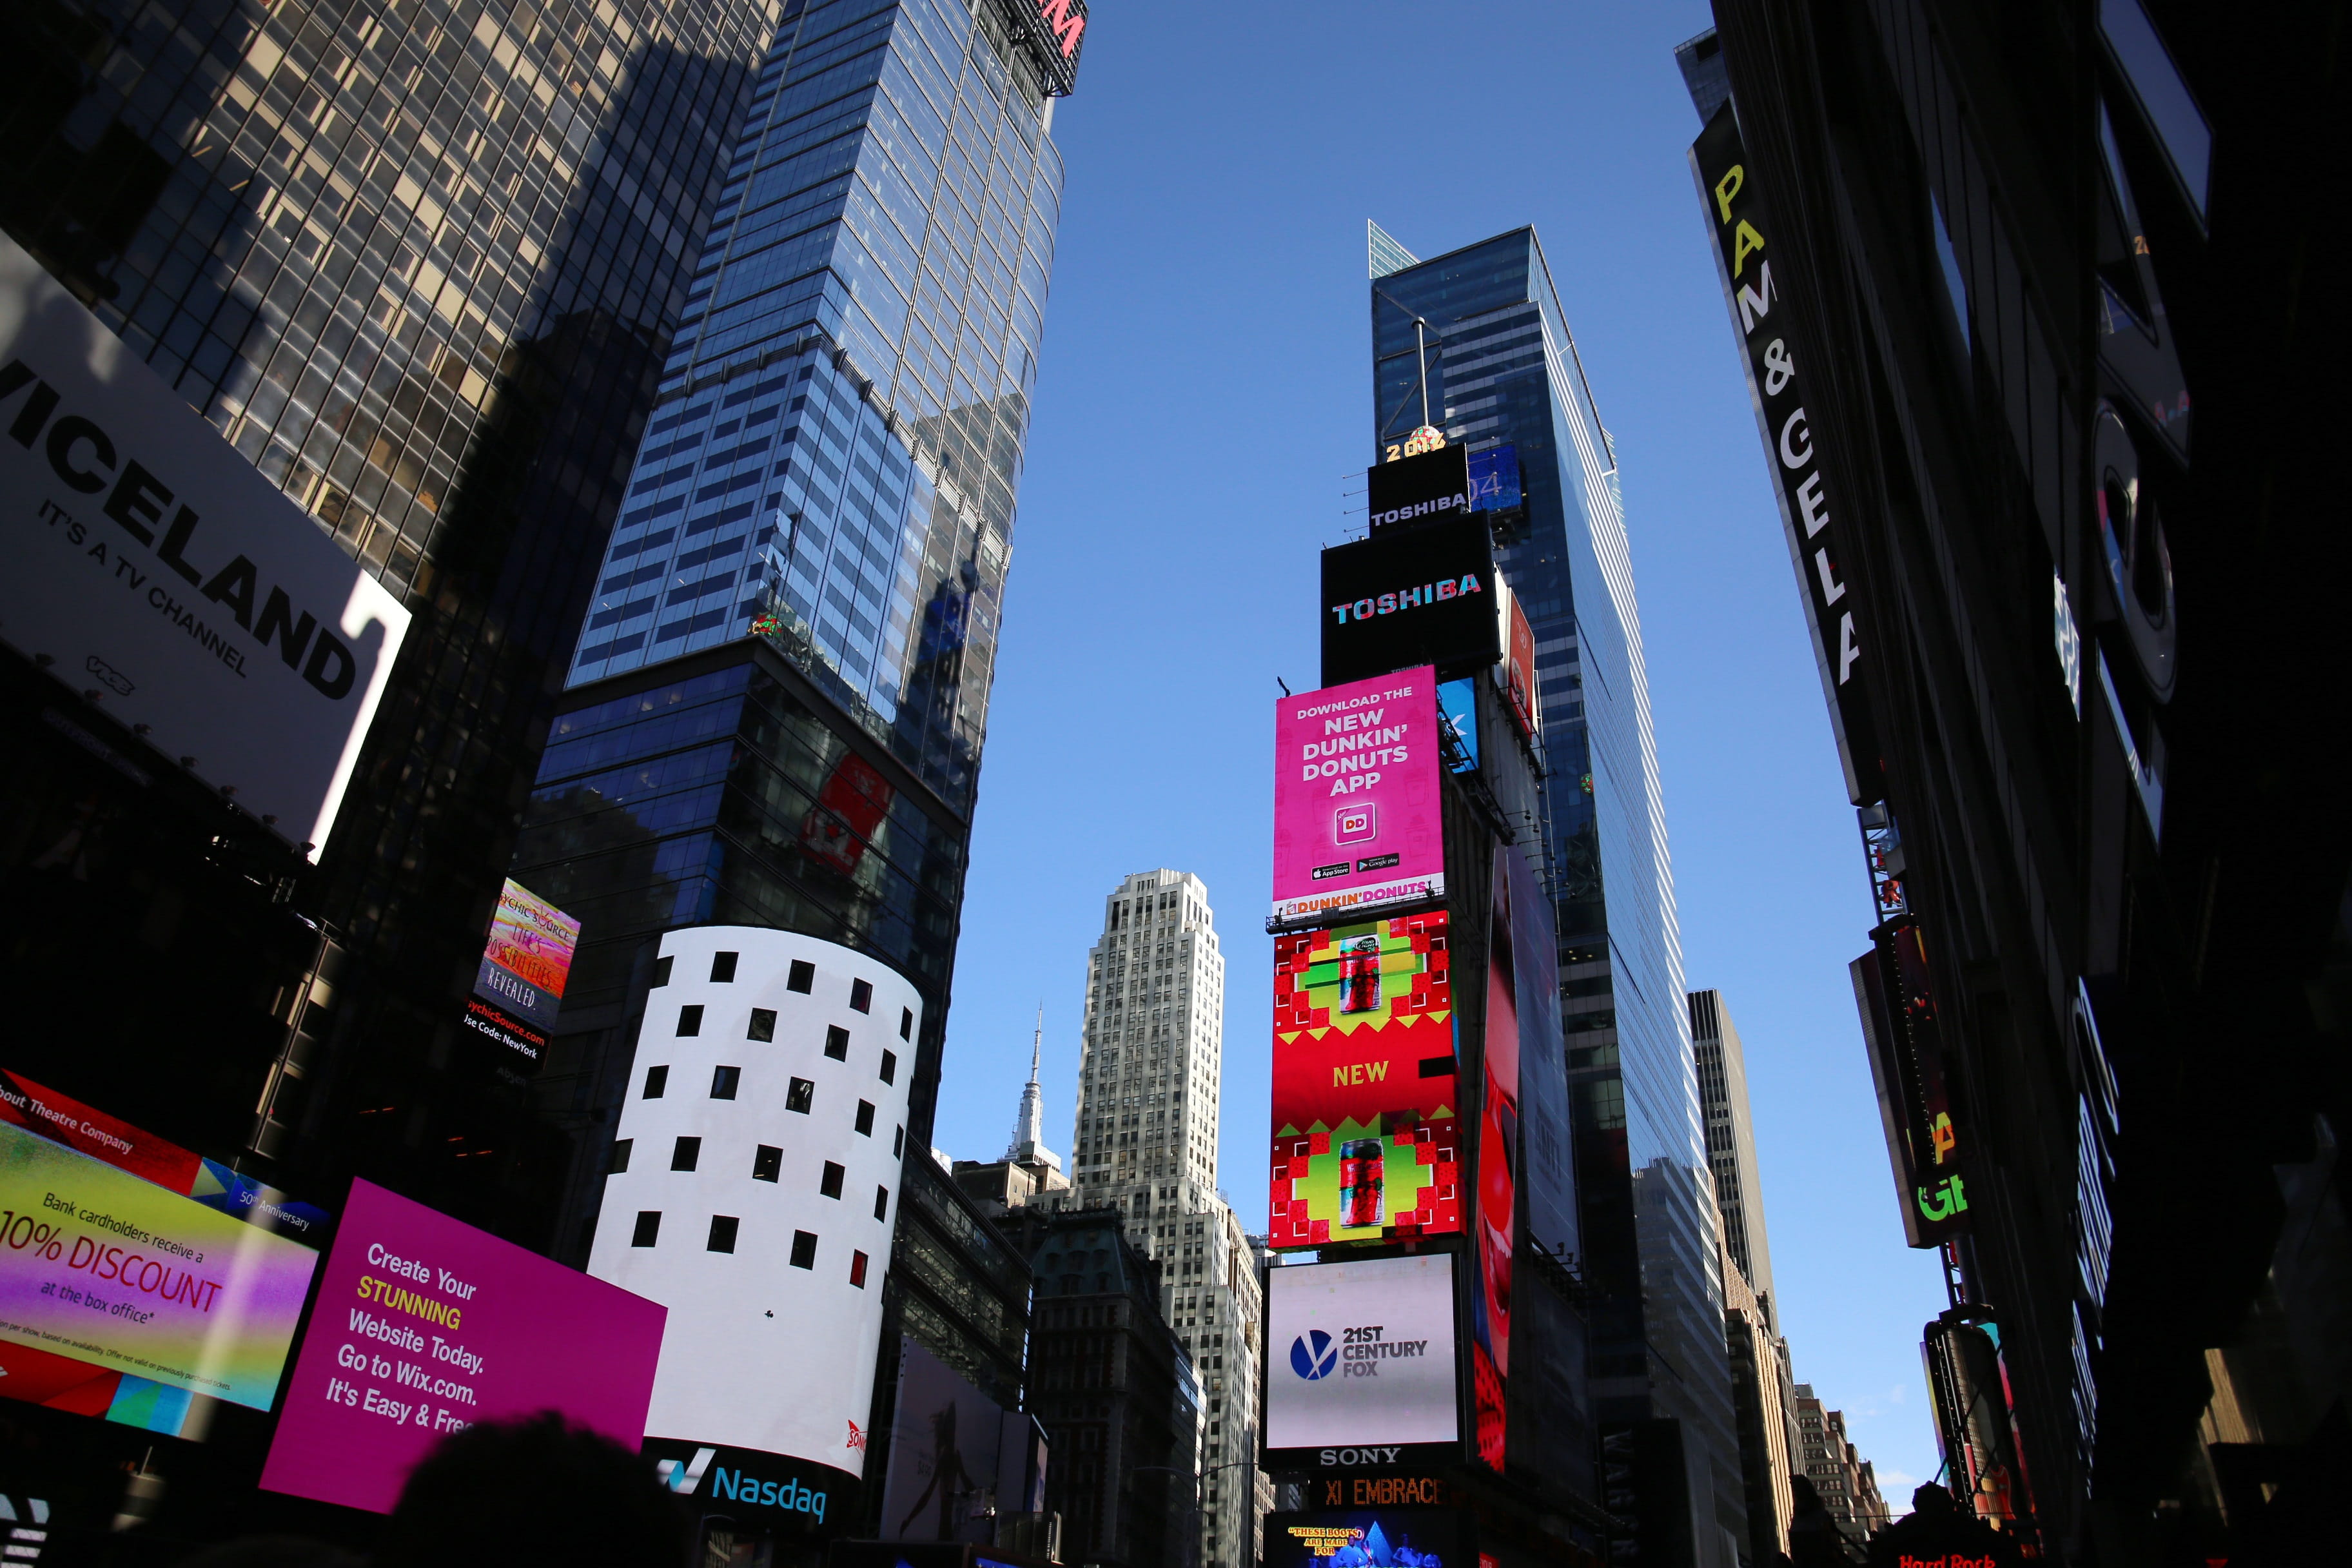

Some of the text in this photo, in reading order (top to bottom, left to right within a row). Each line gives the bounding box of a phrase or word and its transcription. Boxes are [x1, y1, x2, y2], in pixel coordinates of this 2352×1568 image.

[1715, 164, 1860, 685] PAM & GELA
[1386, 432, 1447, 462] 2016
[1371, 493, 1466, 526] TOSHIBA
[37, 499, 248, 678] IT'S A TV CHANNEL
[1333, 573, 1482, 625] TOSHIBA
[1297, 686, 1413, 720] DOWNLOAD THE
[1325, 708, 1384, 736] NEW
[1303, 723, 1408, 761] DUNKIN'
[1303, 745, 1408, 782] DONUTS
[1329, 772, 1381, 797] APP
[1346, 818, 1365, 830] DD
[487, 967, 536, 1010] REVEALED.
[479, 1022, 502, 1040] Code:
[503, 1034, 538, 1059] NewYork
[1333, 1061, 1389, 1087] NEW
[31, 1099, 77, 1130] Theatre
[80, 1122, 133, 1155] Company
[43, 1192, 204, 1264] Bank cardholders receive a
[239, 1191, 309, 1231] 50th Anniversary
[0, 1210, 223, 1313] 10% DISCOUNT
[368, 1242, 477, 1301] Create Your
[41, 1280, 55, 1295] at
[60, 1286, 82, 1304] the
[84, 1292, 109, 1312] box
[357, 1275, 462, 1331] STUNNING
[349, 1308, 484, 1375] Website Today.
[1342, 1340, 1428, 1361] CENTURY
[1343, 1326, 1384, 1344] 21ST
[338, 1344, 477, 1406] Go to Wix.com.
[1344, 1361, 1378, 1378] FOX
[326, 1377, 358, 1407] It's
[363, 1387, 413, 1426] Easy
[415, 1403, 429, 1427] &
[1320, 1447, 1401, 1466] SONY
[712, 1467, 826, 1525] Nasdaq
[1354, 1478, 1448, 1505] EMBRACE
[1304, 1538, 1349, 1547] ARE MADE
[1314, 1546, 1337, 1556] FOR
[1326, 1527, 1358, 1538] BOOTS
